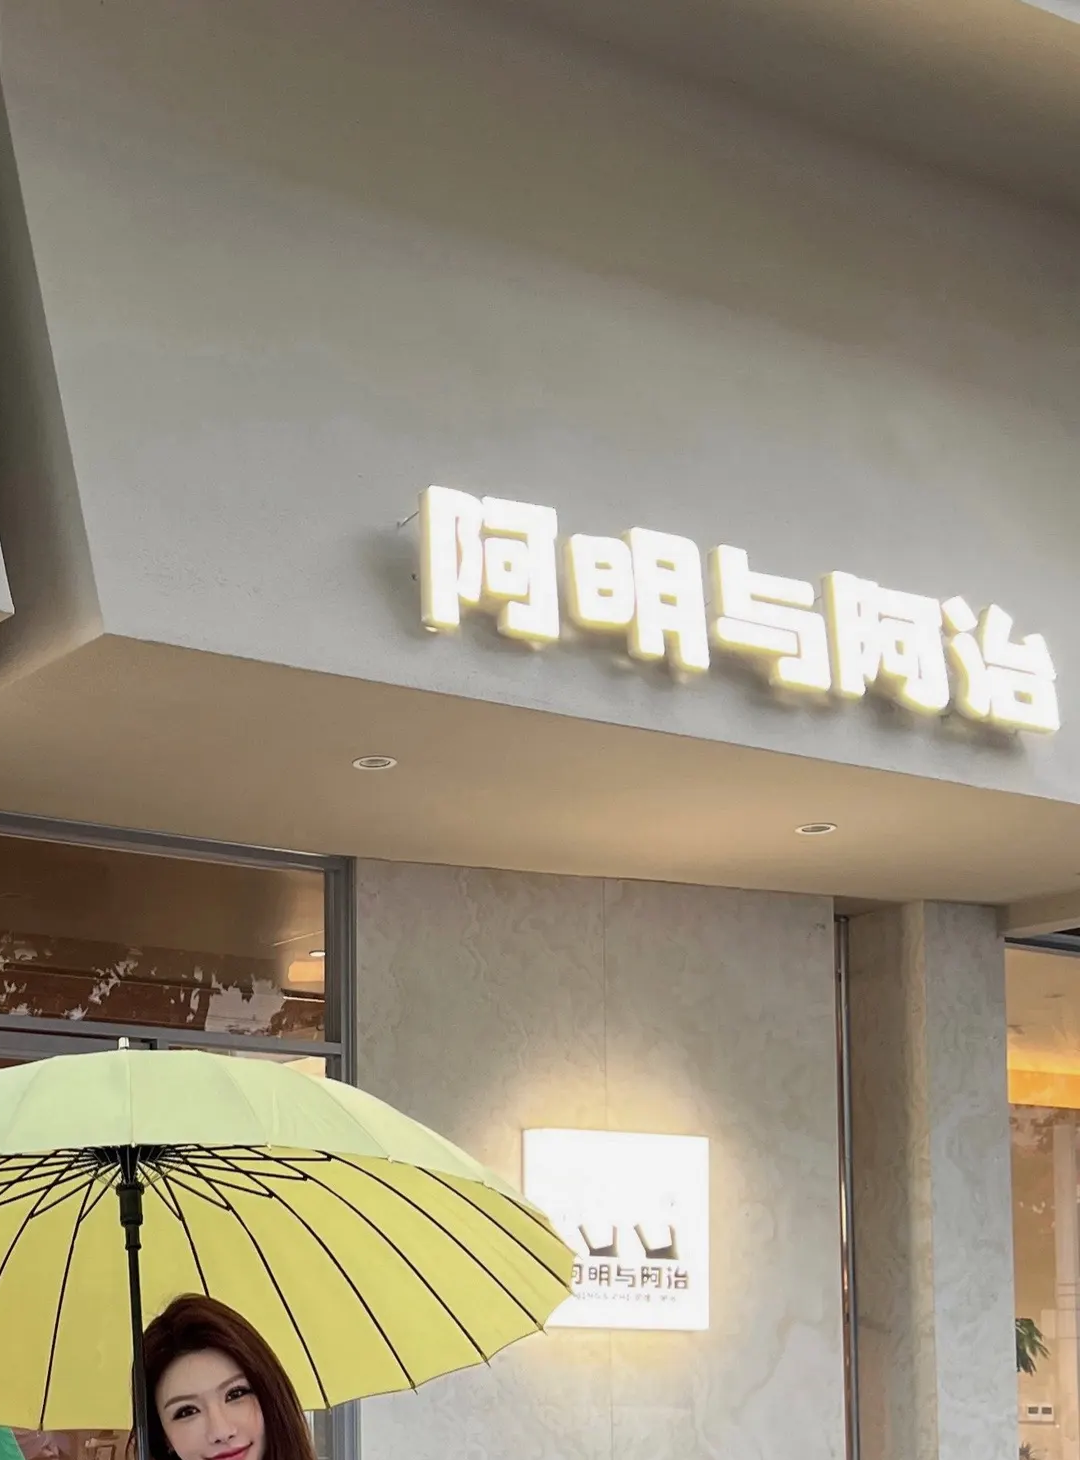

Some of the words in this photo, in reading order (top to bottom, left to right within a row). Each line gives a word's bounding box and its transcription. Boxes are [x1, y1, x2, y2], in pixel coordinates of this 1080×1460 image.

[418, 484, 1061, 735] 阿明与阿治
